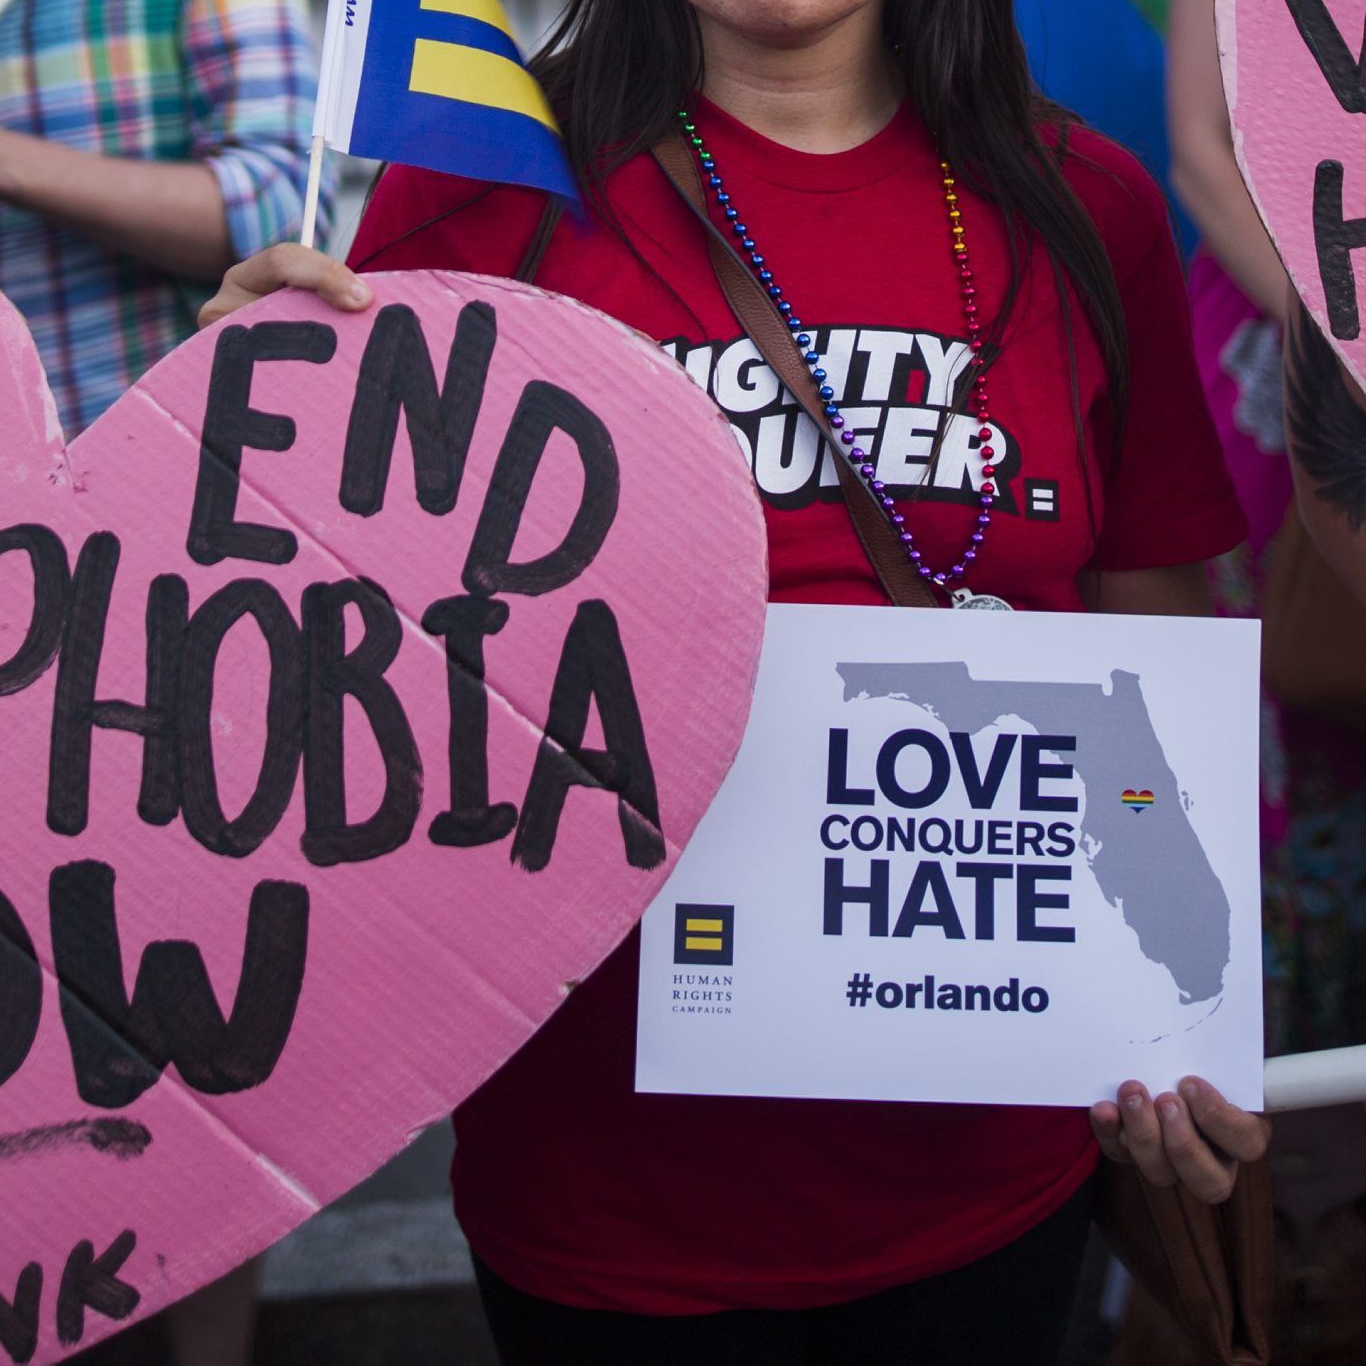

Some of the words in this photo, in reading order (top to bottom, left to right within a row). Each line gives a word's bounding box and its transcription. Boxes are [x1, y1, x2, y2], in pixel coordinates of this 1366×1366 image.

[661, 329, 976, 413] IGHTY
[186, 300, 621, 596] END
[732, 407, 1007, 496] UEER
[827, 727, 1078, 812] LOVE
[820, 814, 1076, 857] CONQUERS
[822, 857, 1076, 943] HATE
[672, 974, 733, 986] HUMAN
[672, 990, 733, 1002] RIGHTS
[672, 1005, 733, 1014] CAMPAIGN
[846, 973, 1049, 1013] #orlando
